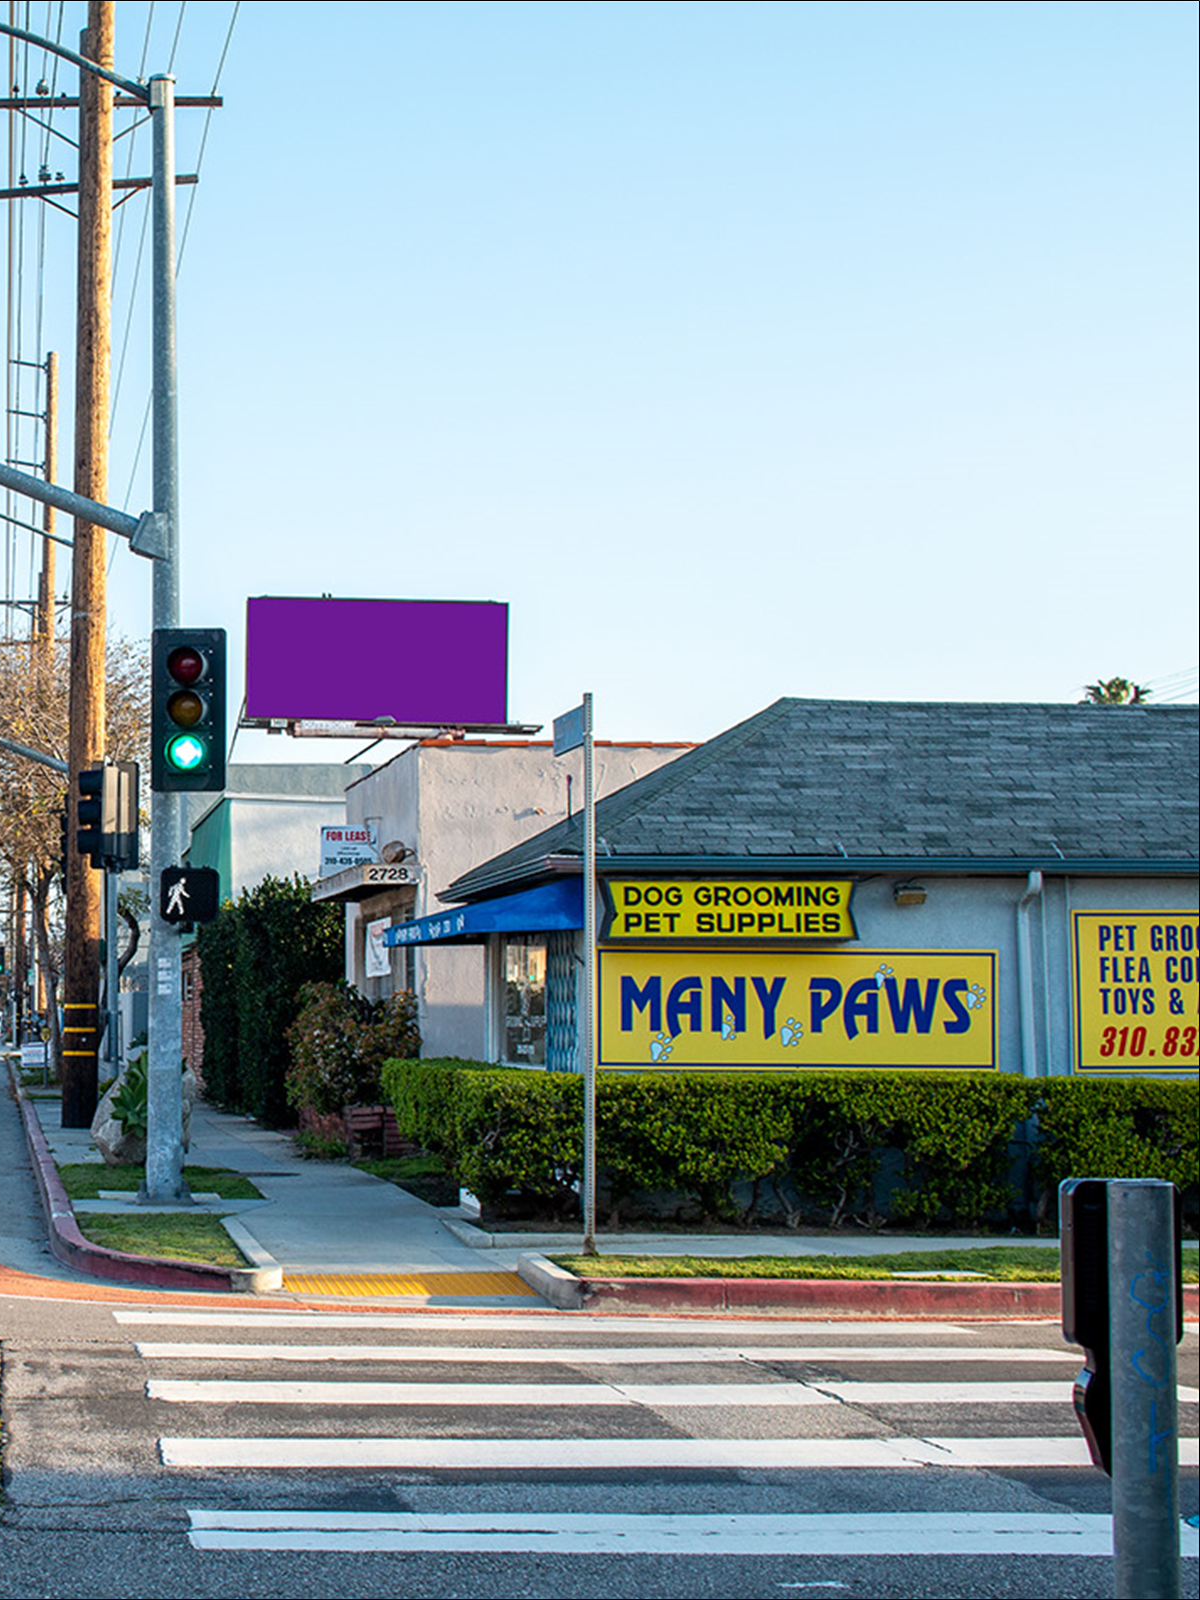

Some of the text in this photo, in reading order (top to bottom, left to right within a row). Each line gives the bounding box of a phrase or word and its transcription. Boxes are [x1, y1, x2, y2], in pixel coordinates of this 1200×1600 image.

[325, 831, 371, 842] FOR LEASE
[368, 867, 409, 881] 2728
[623, 886, 841, 907] DOG GROOMING
[623, 913, 841, 933] PET SUPPLIES
[1098, 925, 1138, 952] PET
[1099, 956, 1199, 983] FLEA CO
[620, 975, 972, 1041] MANY PAWS
[1099, 987, 1185, 1015] TOYS &
[1099, 1025, 1199, 1057] 310.83
